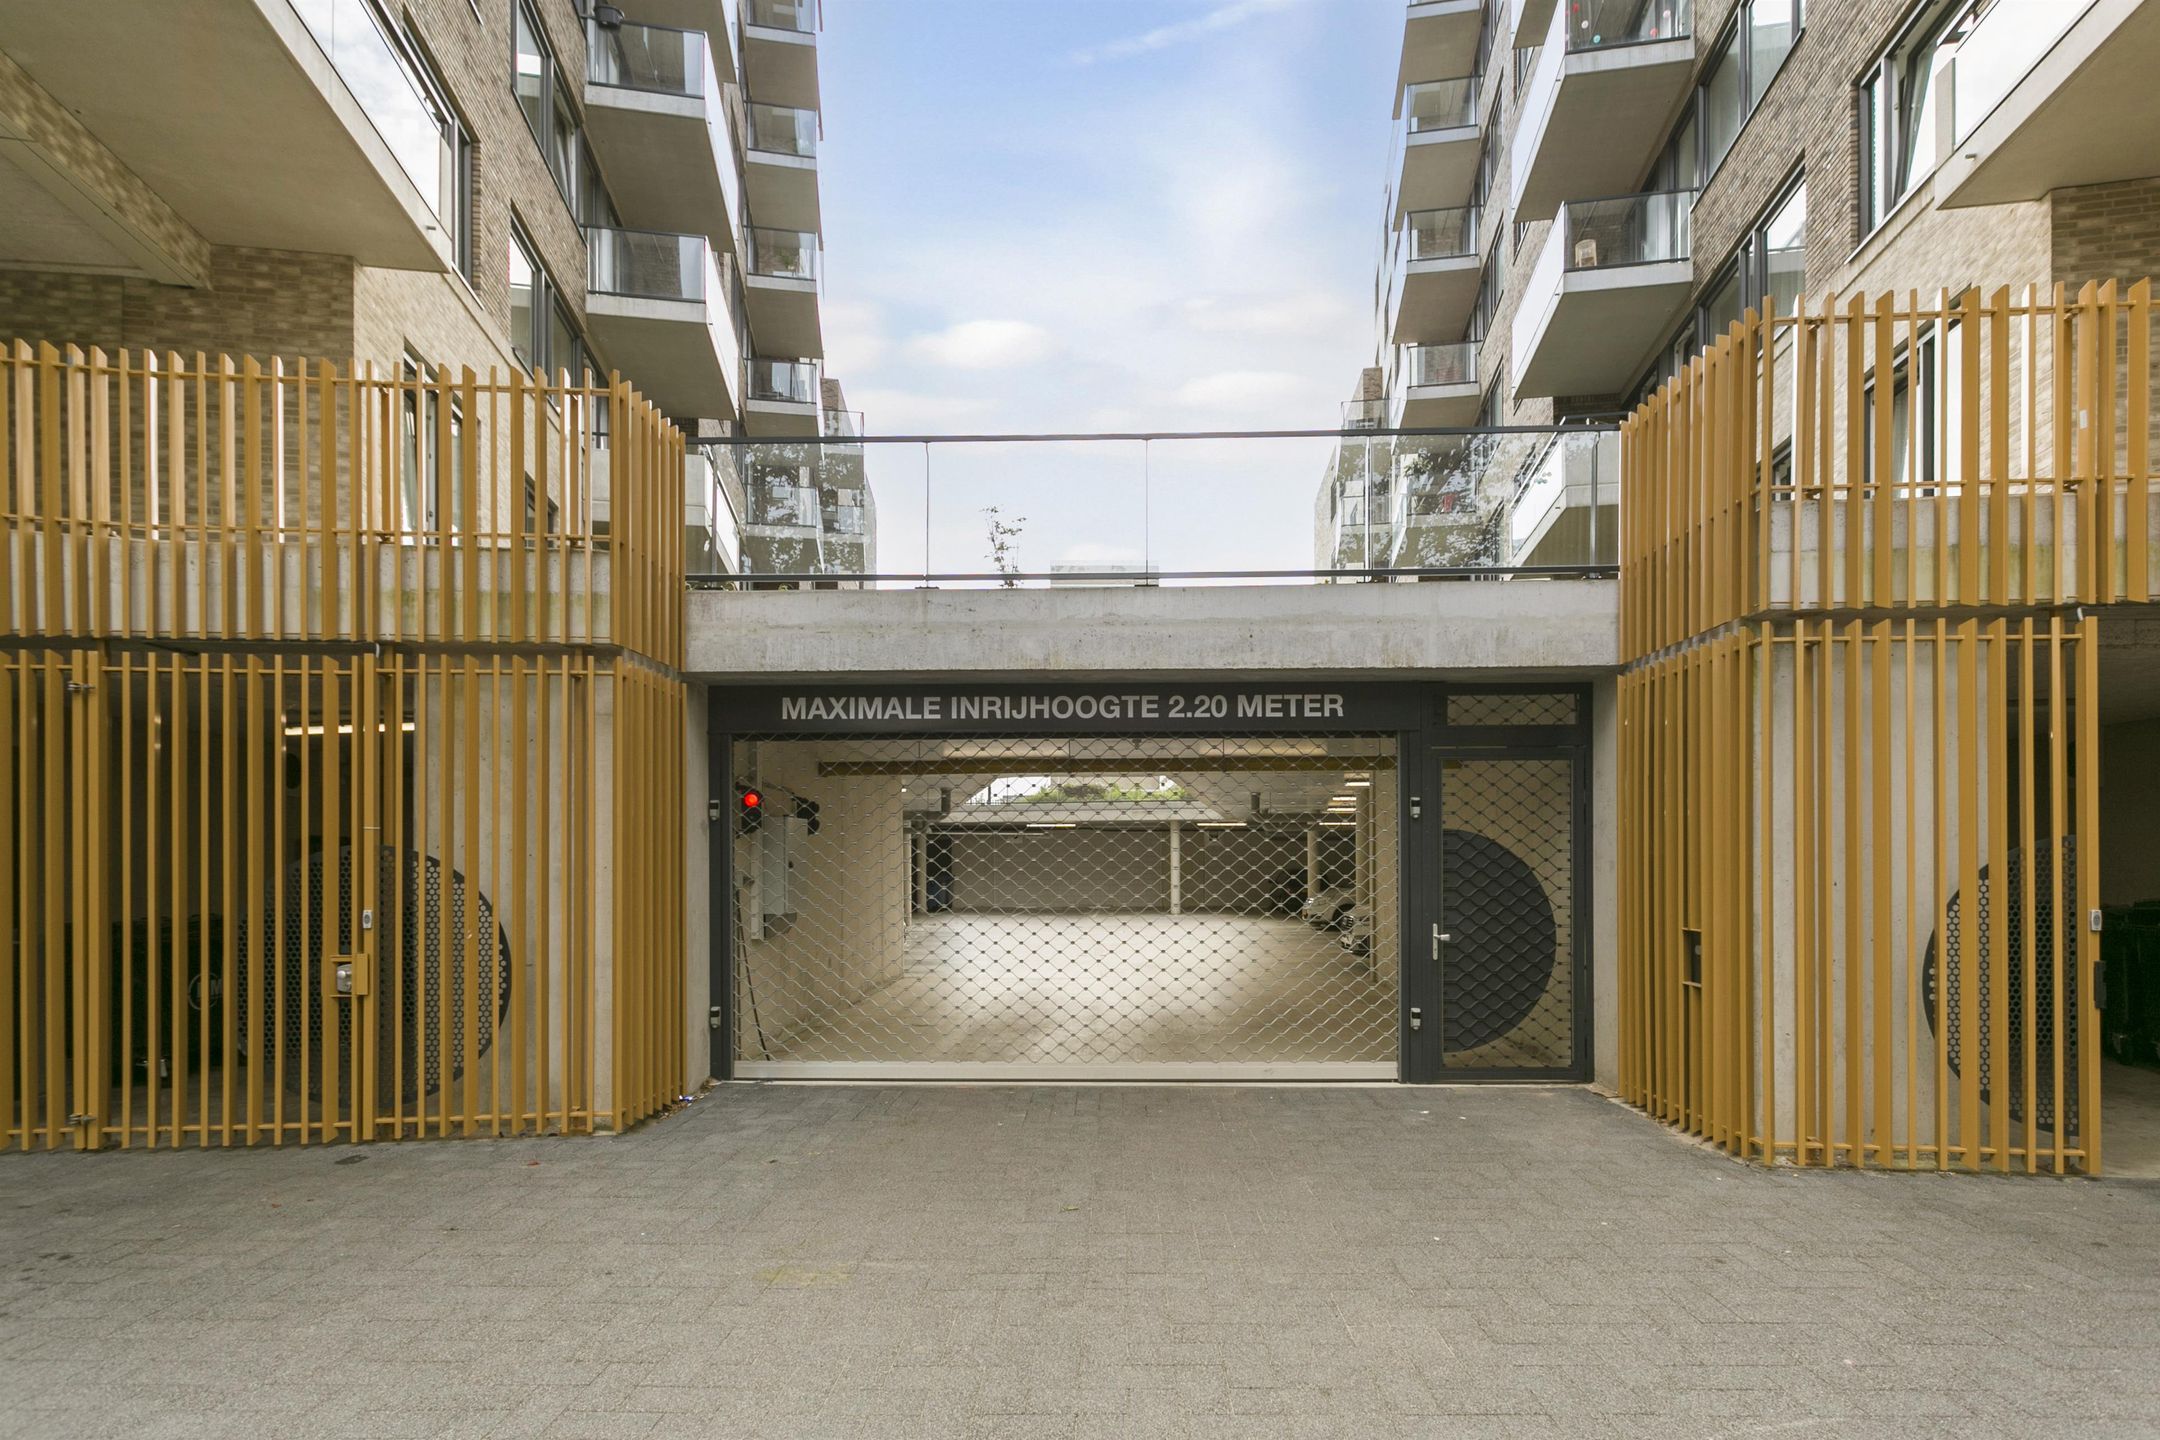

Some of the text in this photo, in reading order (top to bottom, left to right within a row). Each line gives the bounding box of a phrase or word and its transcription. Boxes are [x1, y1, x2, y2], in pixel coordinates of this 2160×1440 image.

[782, 694, 1344, 720] MAXIMALE INRIJHOOGTE 2.20 METER
